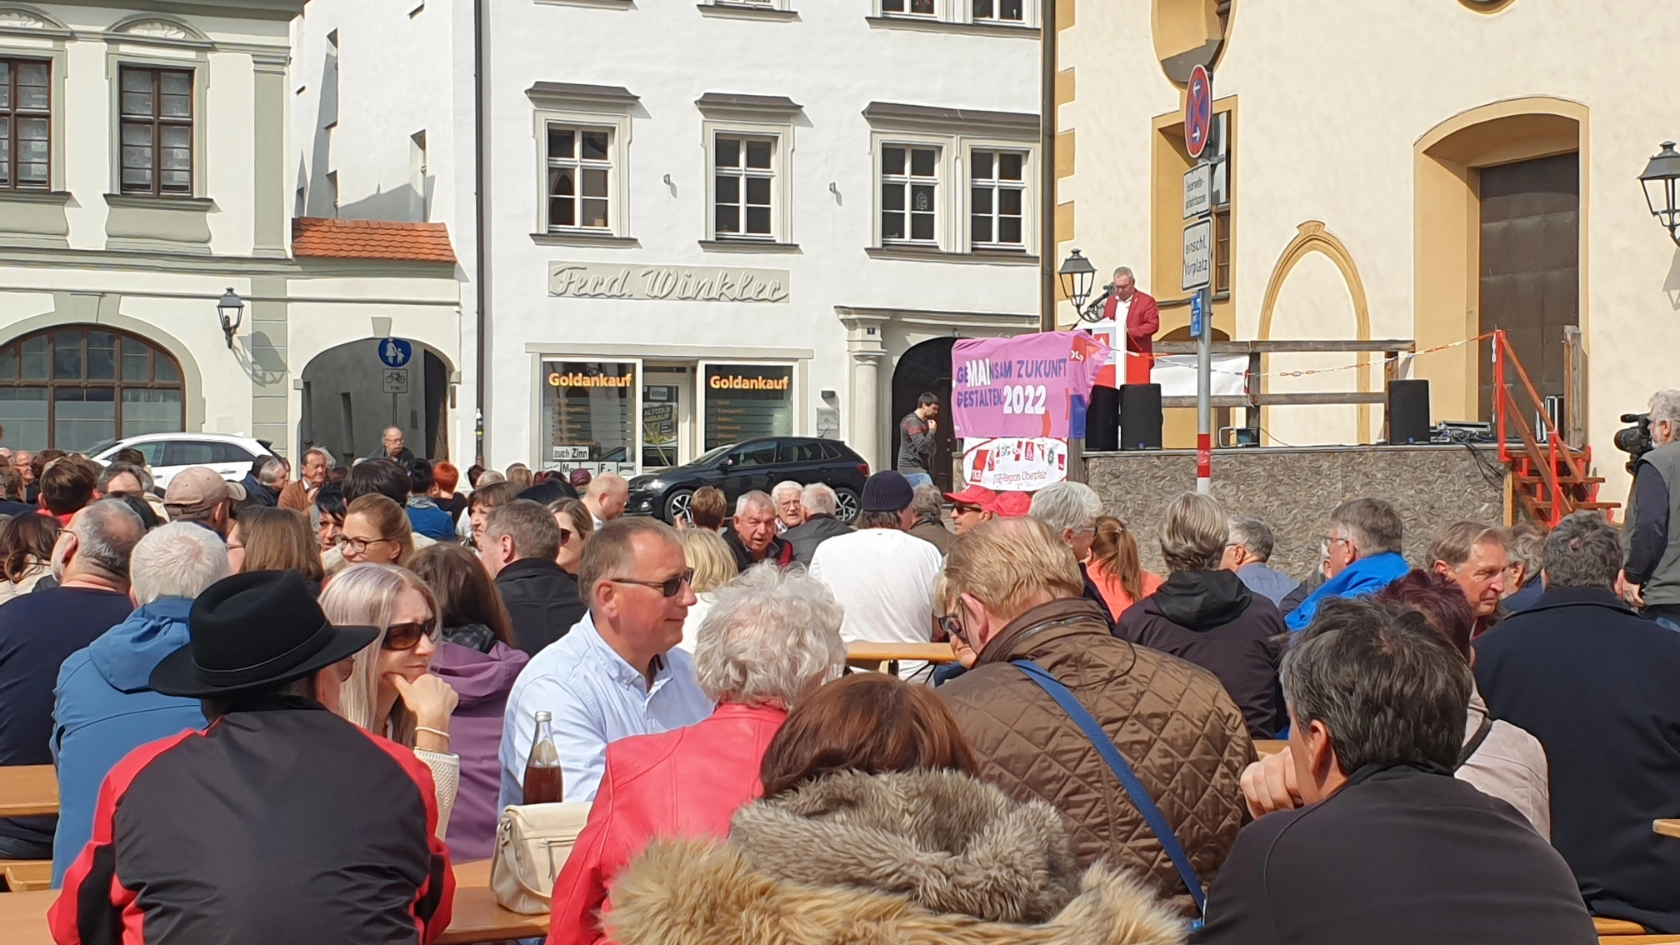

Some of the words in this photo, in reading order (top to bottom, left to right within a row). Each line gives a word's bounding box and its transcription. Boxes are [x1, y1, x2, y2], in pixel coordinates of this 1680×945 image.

[1185, 234, 1207, 255] einschl.
[550, 264, 633, 298] Ferd.
[641, 266, 788, 302] Winkler
[1017, 357, 1068, 379] ZUKUNFT
[549, 372, 632, 387] Goldankauf
[710, 375, 789, 390] Goldankauf
[957, 388, 1003, 408] GESTALTEN
[1003, 384, 1048, 415] 2022
[572, 447, 588, 458] Zinn
